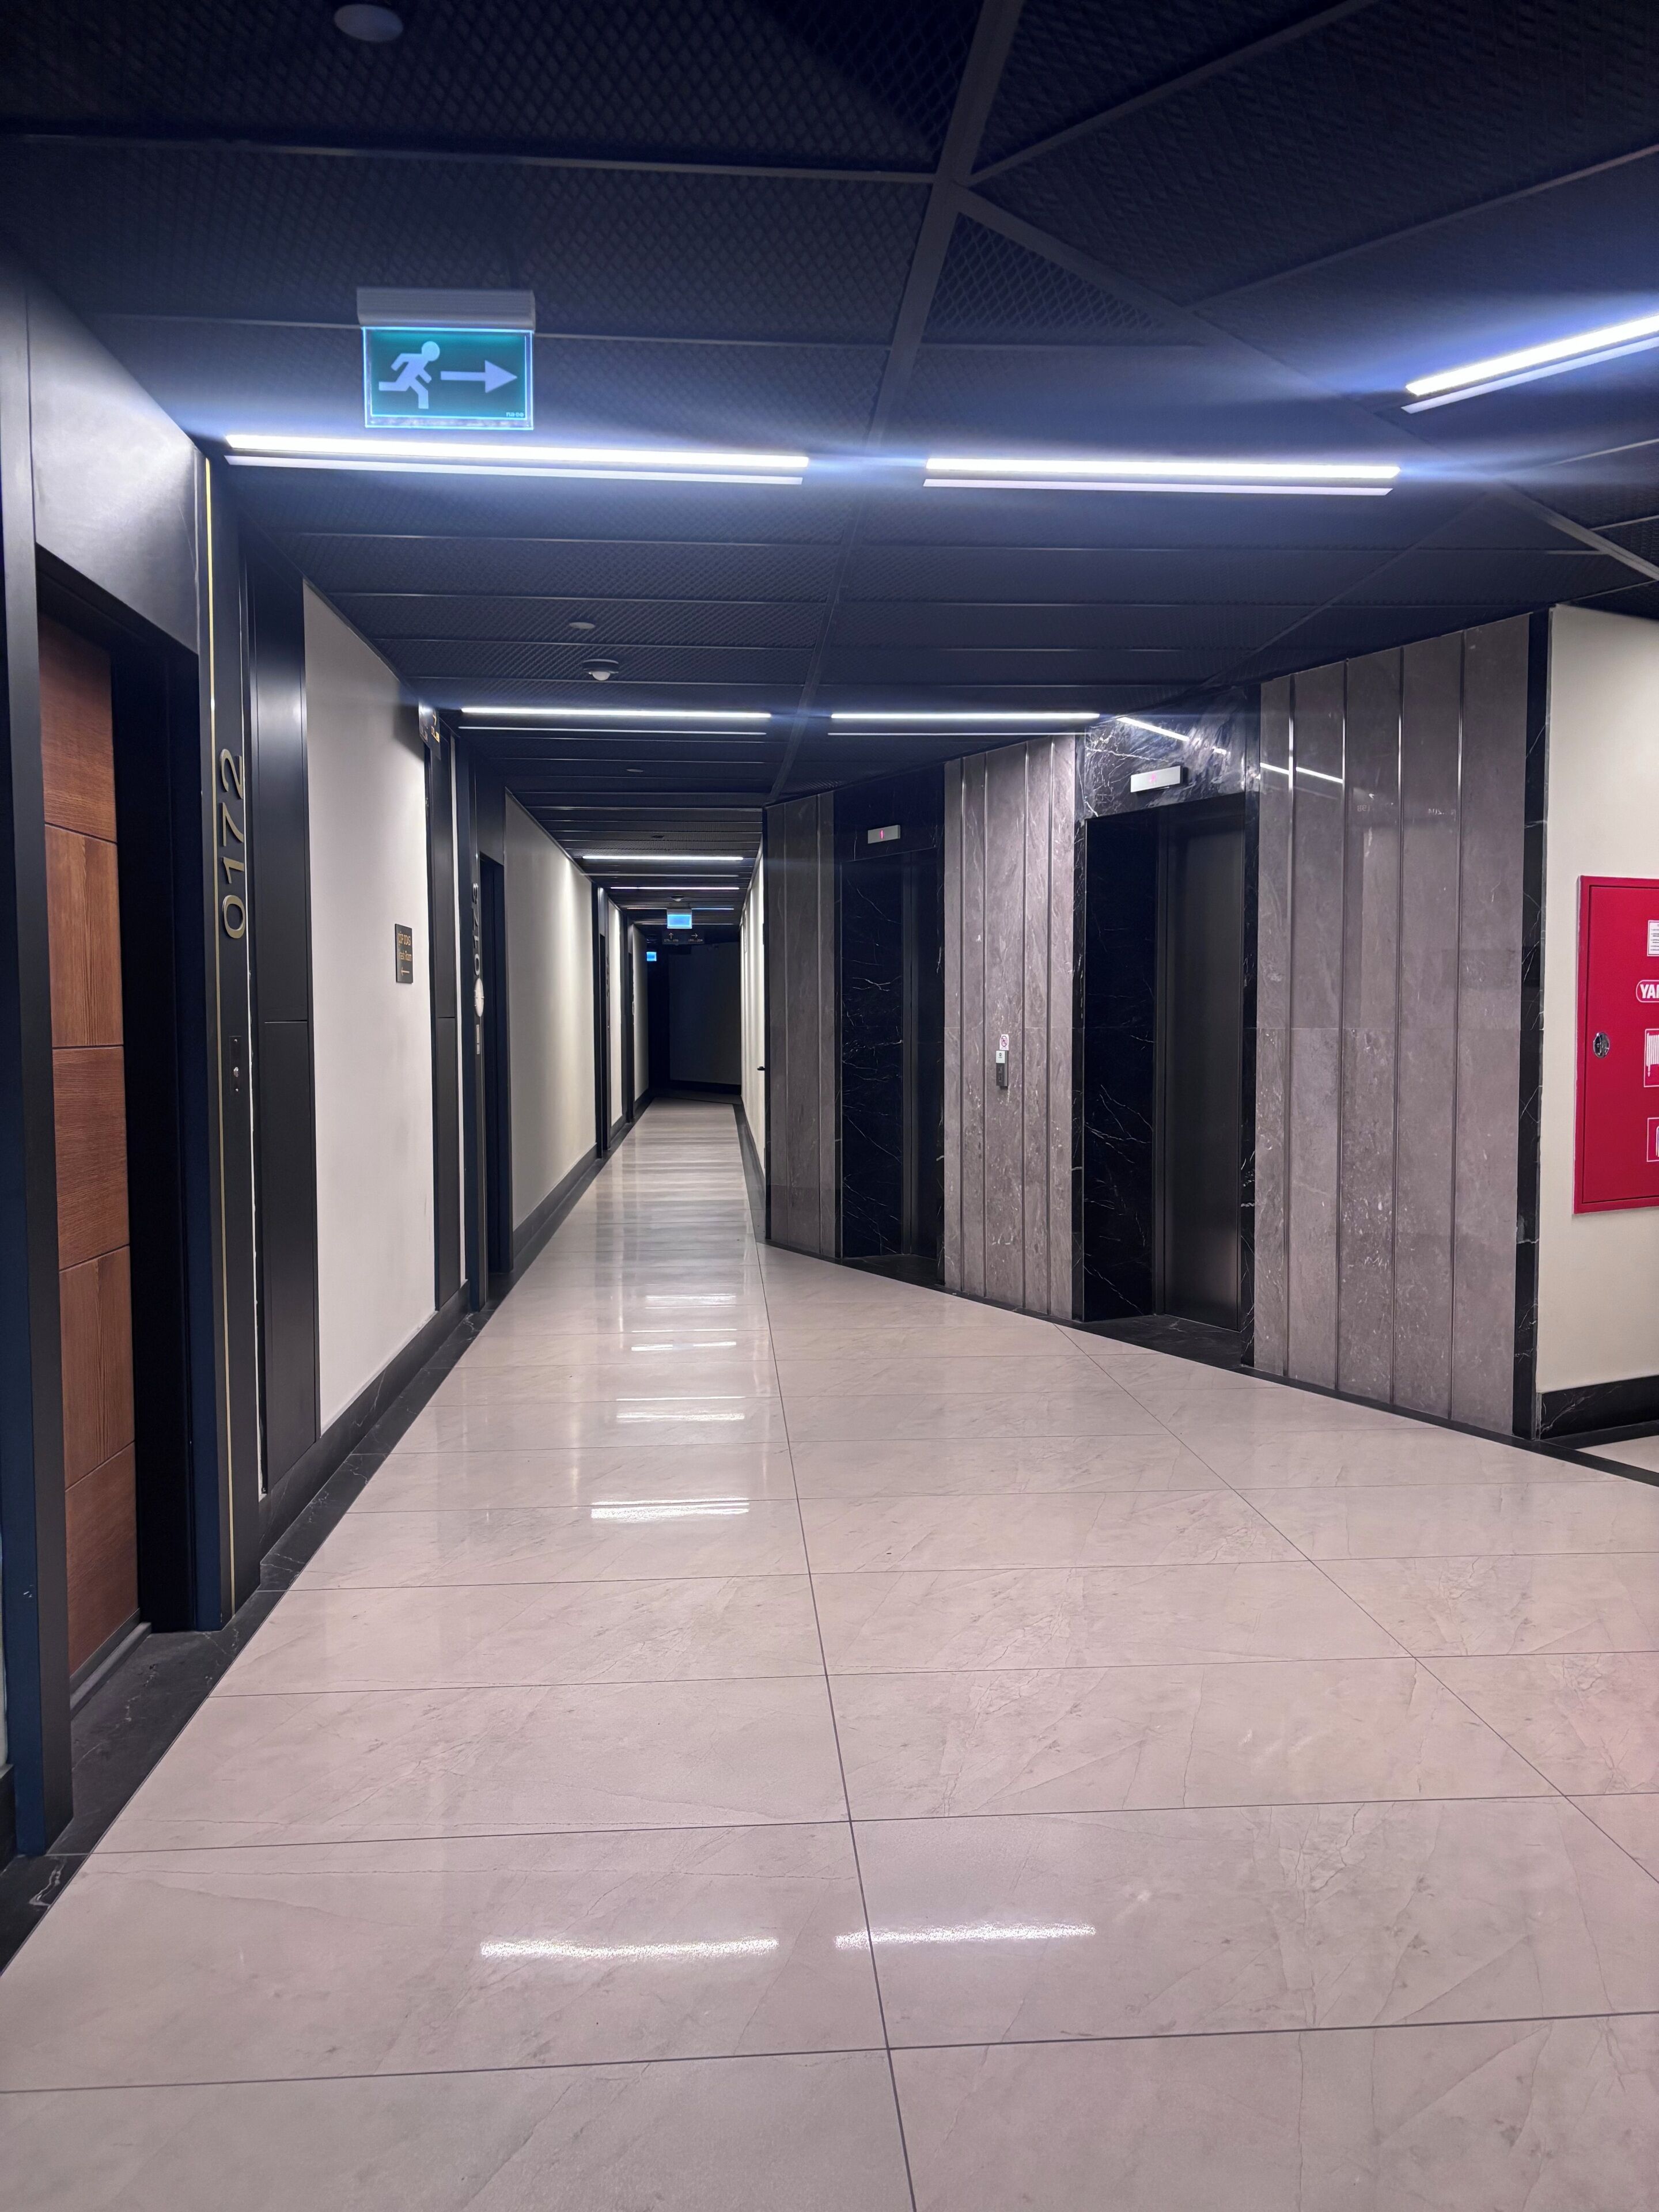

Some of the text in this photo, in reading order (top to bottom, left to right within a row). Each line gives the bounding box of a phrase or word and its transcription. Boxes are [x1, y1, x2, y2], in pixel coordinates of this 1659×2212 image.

[219, 747, 245, 940] 0172
[880, 830, 884, 839] 1
[472, 882, 480, 976] 0173
